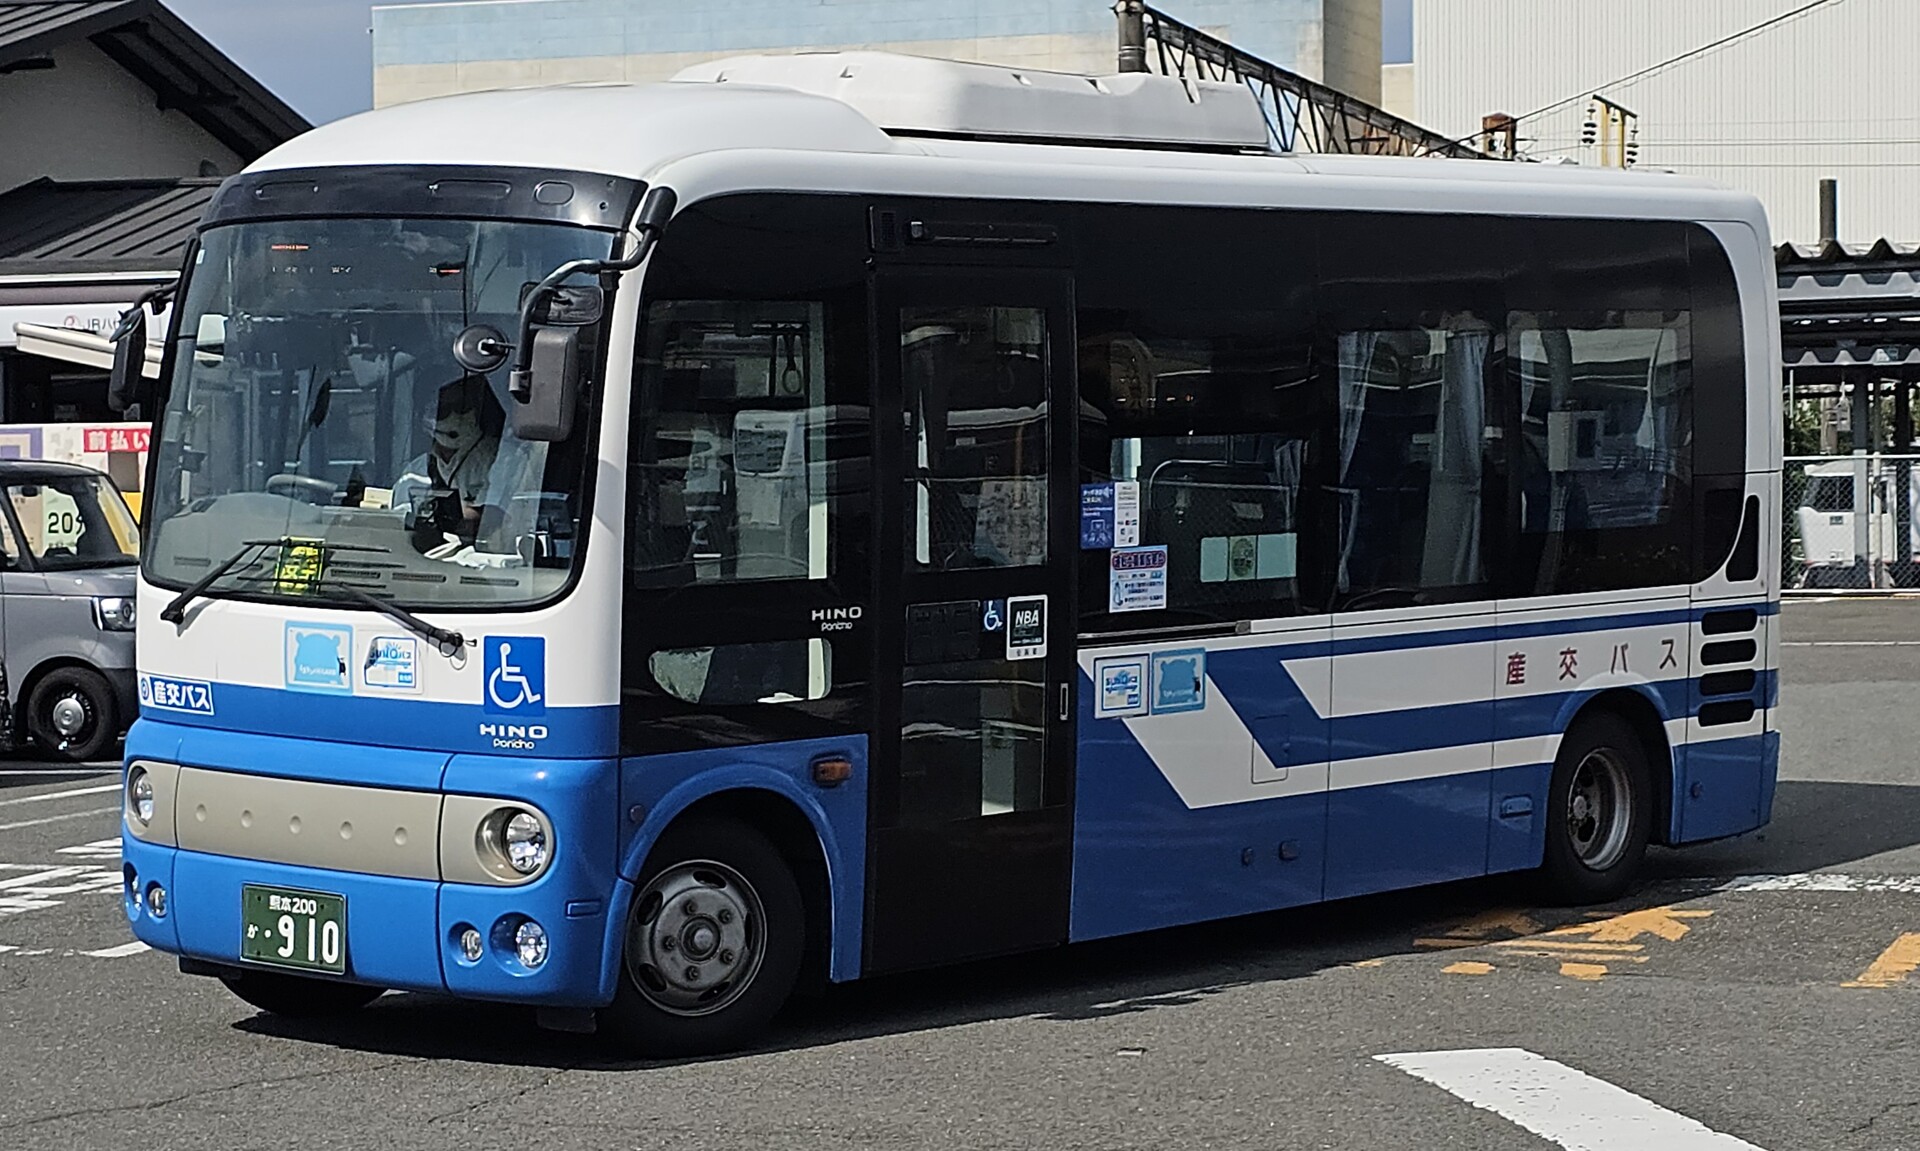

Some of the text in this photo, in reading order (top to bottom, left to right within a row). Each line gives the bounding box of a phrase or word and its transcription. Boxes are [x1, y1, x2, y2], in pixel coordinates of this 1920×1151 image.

[811, 606, 862, 621] HINO
[1015, 609, 1039, 627] NBA
[1506, 638, 1678, 685] 産交バス
[153, 680, 210, 710] 産交バス
[479, 723, 548, 739] HINO
